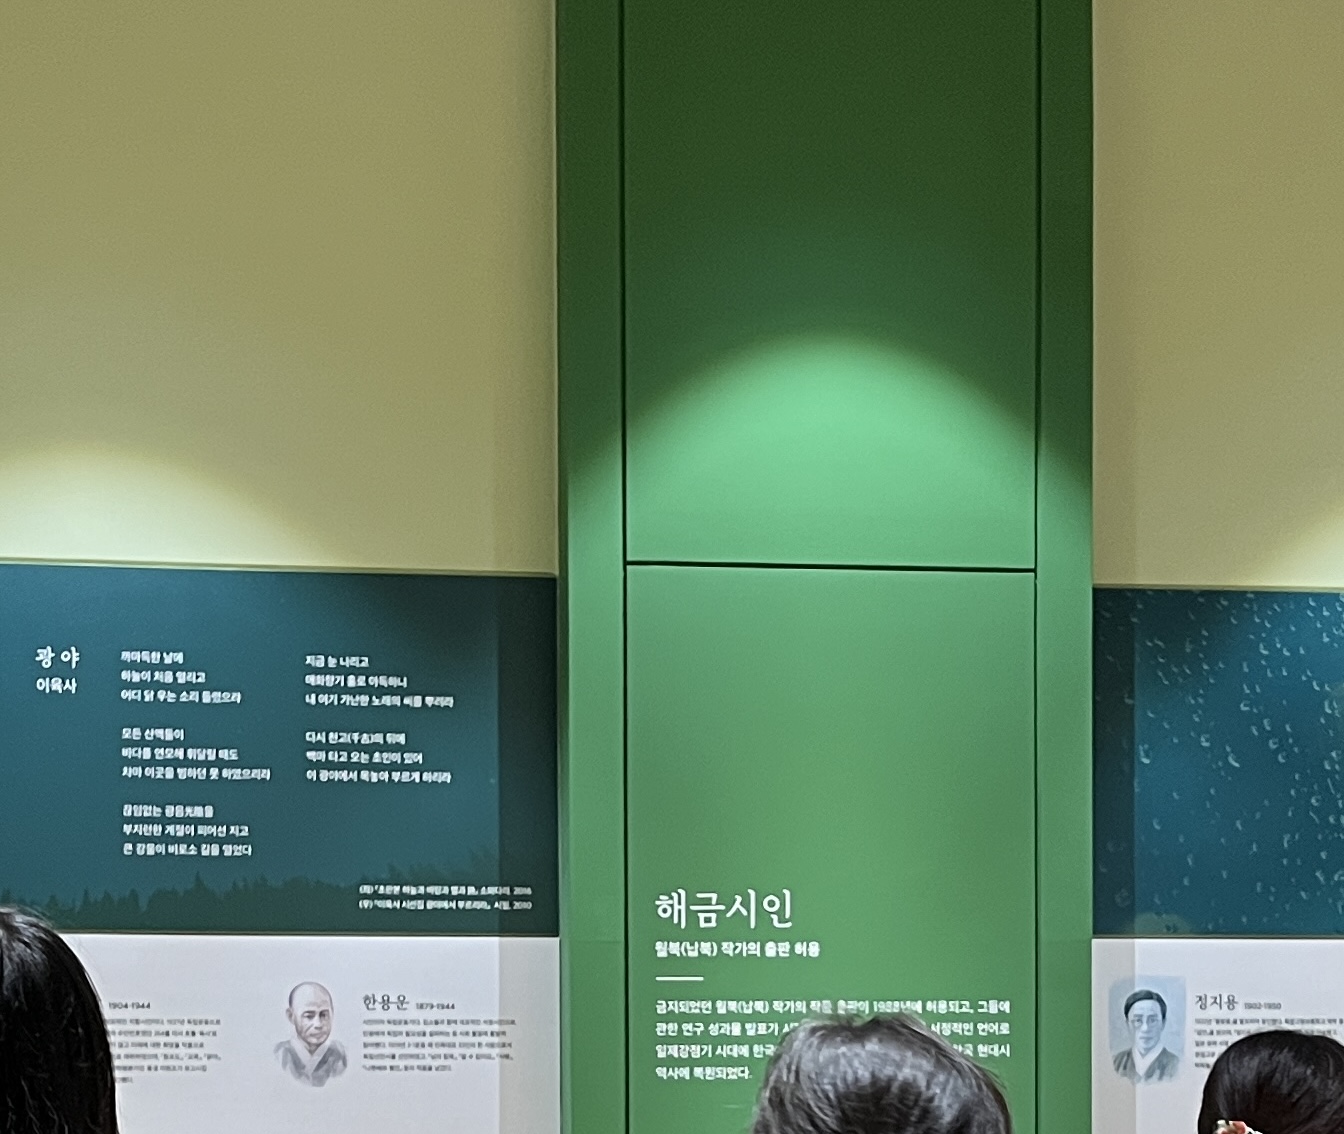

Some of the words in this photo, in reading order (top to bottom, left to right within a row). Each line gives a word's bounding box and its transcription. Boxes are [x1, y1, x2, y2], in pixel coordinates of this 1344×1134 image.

[35, 646, 55, 668] 광
[60, 646, 79, 668] 야
[36, 677, 76, 693] 이육사
[655, 889, 791, 928] 해금시인
[721, 941, 760, 956] 작가의
[362, 993, 409, 1011] 한용운
[772, 1000, 806, 1013] 작가의
[1195, 993, 1239, 1011] 정지용
[681, 1022, 704, 1035] 연구
[976, 1022, 1009, 1035] 언어로
[715, 1044, 749, 1057] 시대에
[977, 1043, 1010, 1057] 현대시
